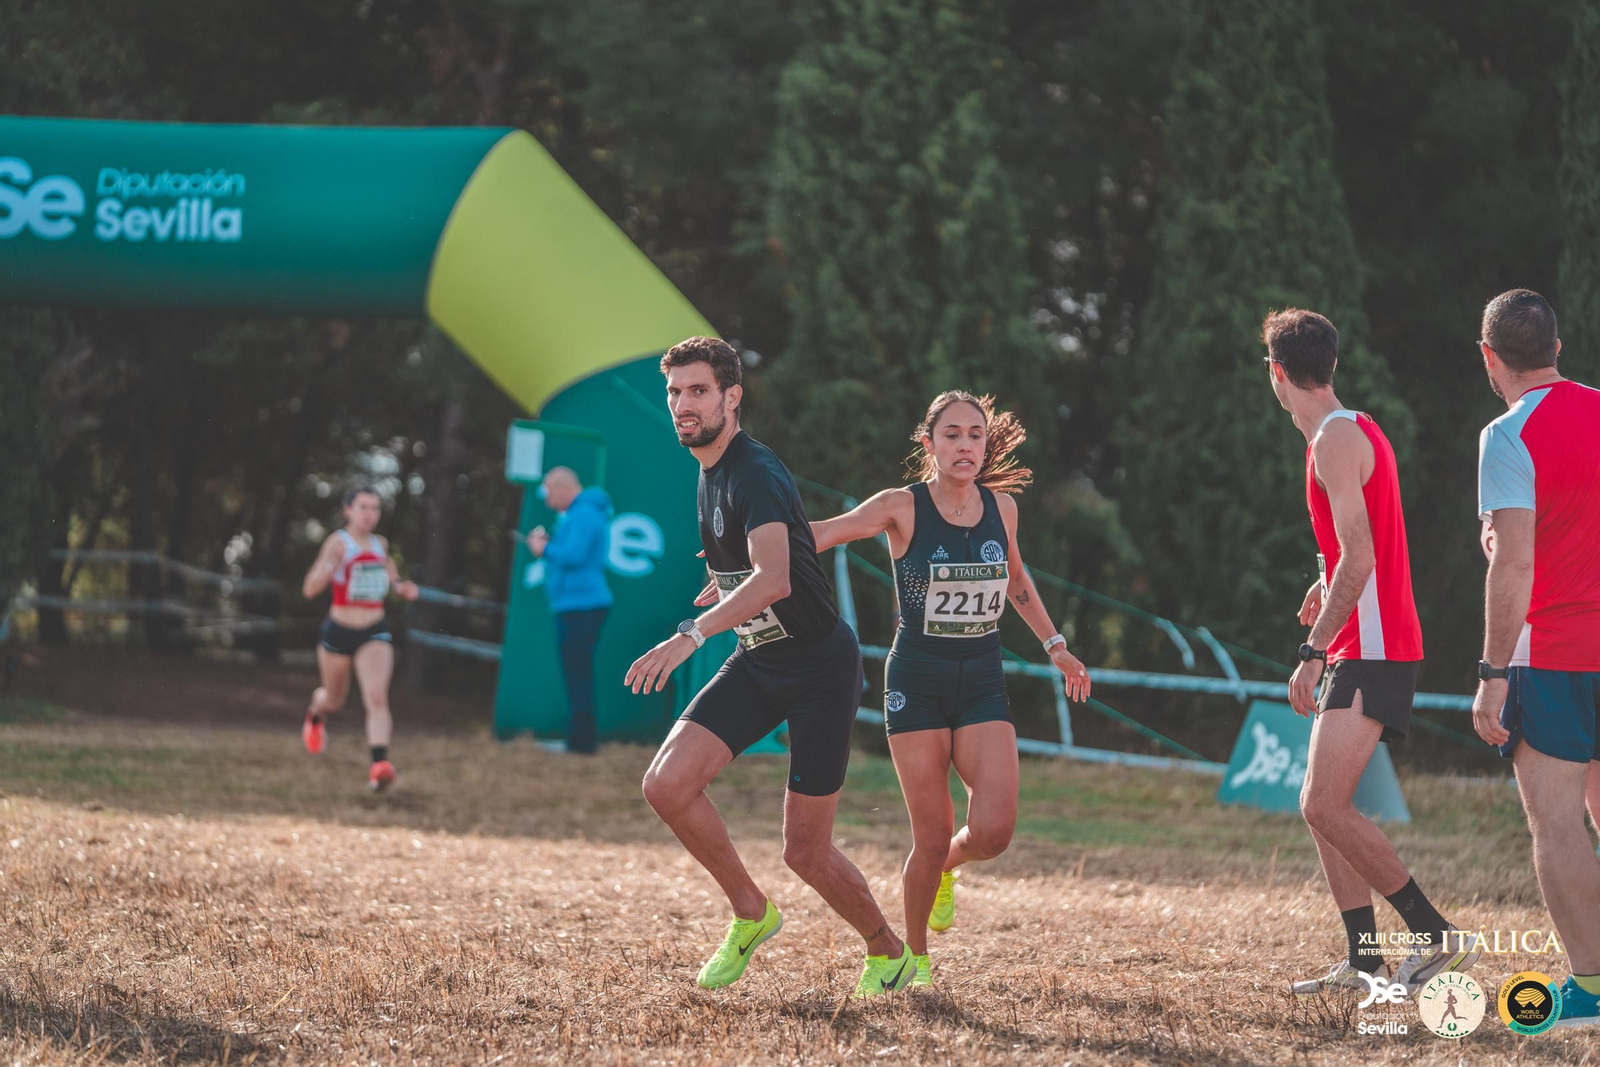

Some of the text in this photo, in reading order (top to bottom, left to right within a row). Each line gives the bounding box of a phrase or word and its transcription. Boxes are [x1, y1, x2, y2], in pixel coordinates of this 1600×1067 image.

[96, 167, 246, 200] Diputación
[94, 197, 243, 242] Sevilla
[955, 566, 992, 577] ITÁLICA
[934, 591, 1001, 616] 2214
